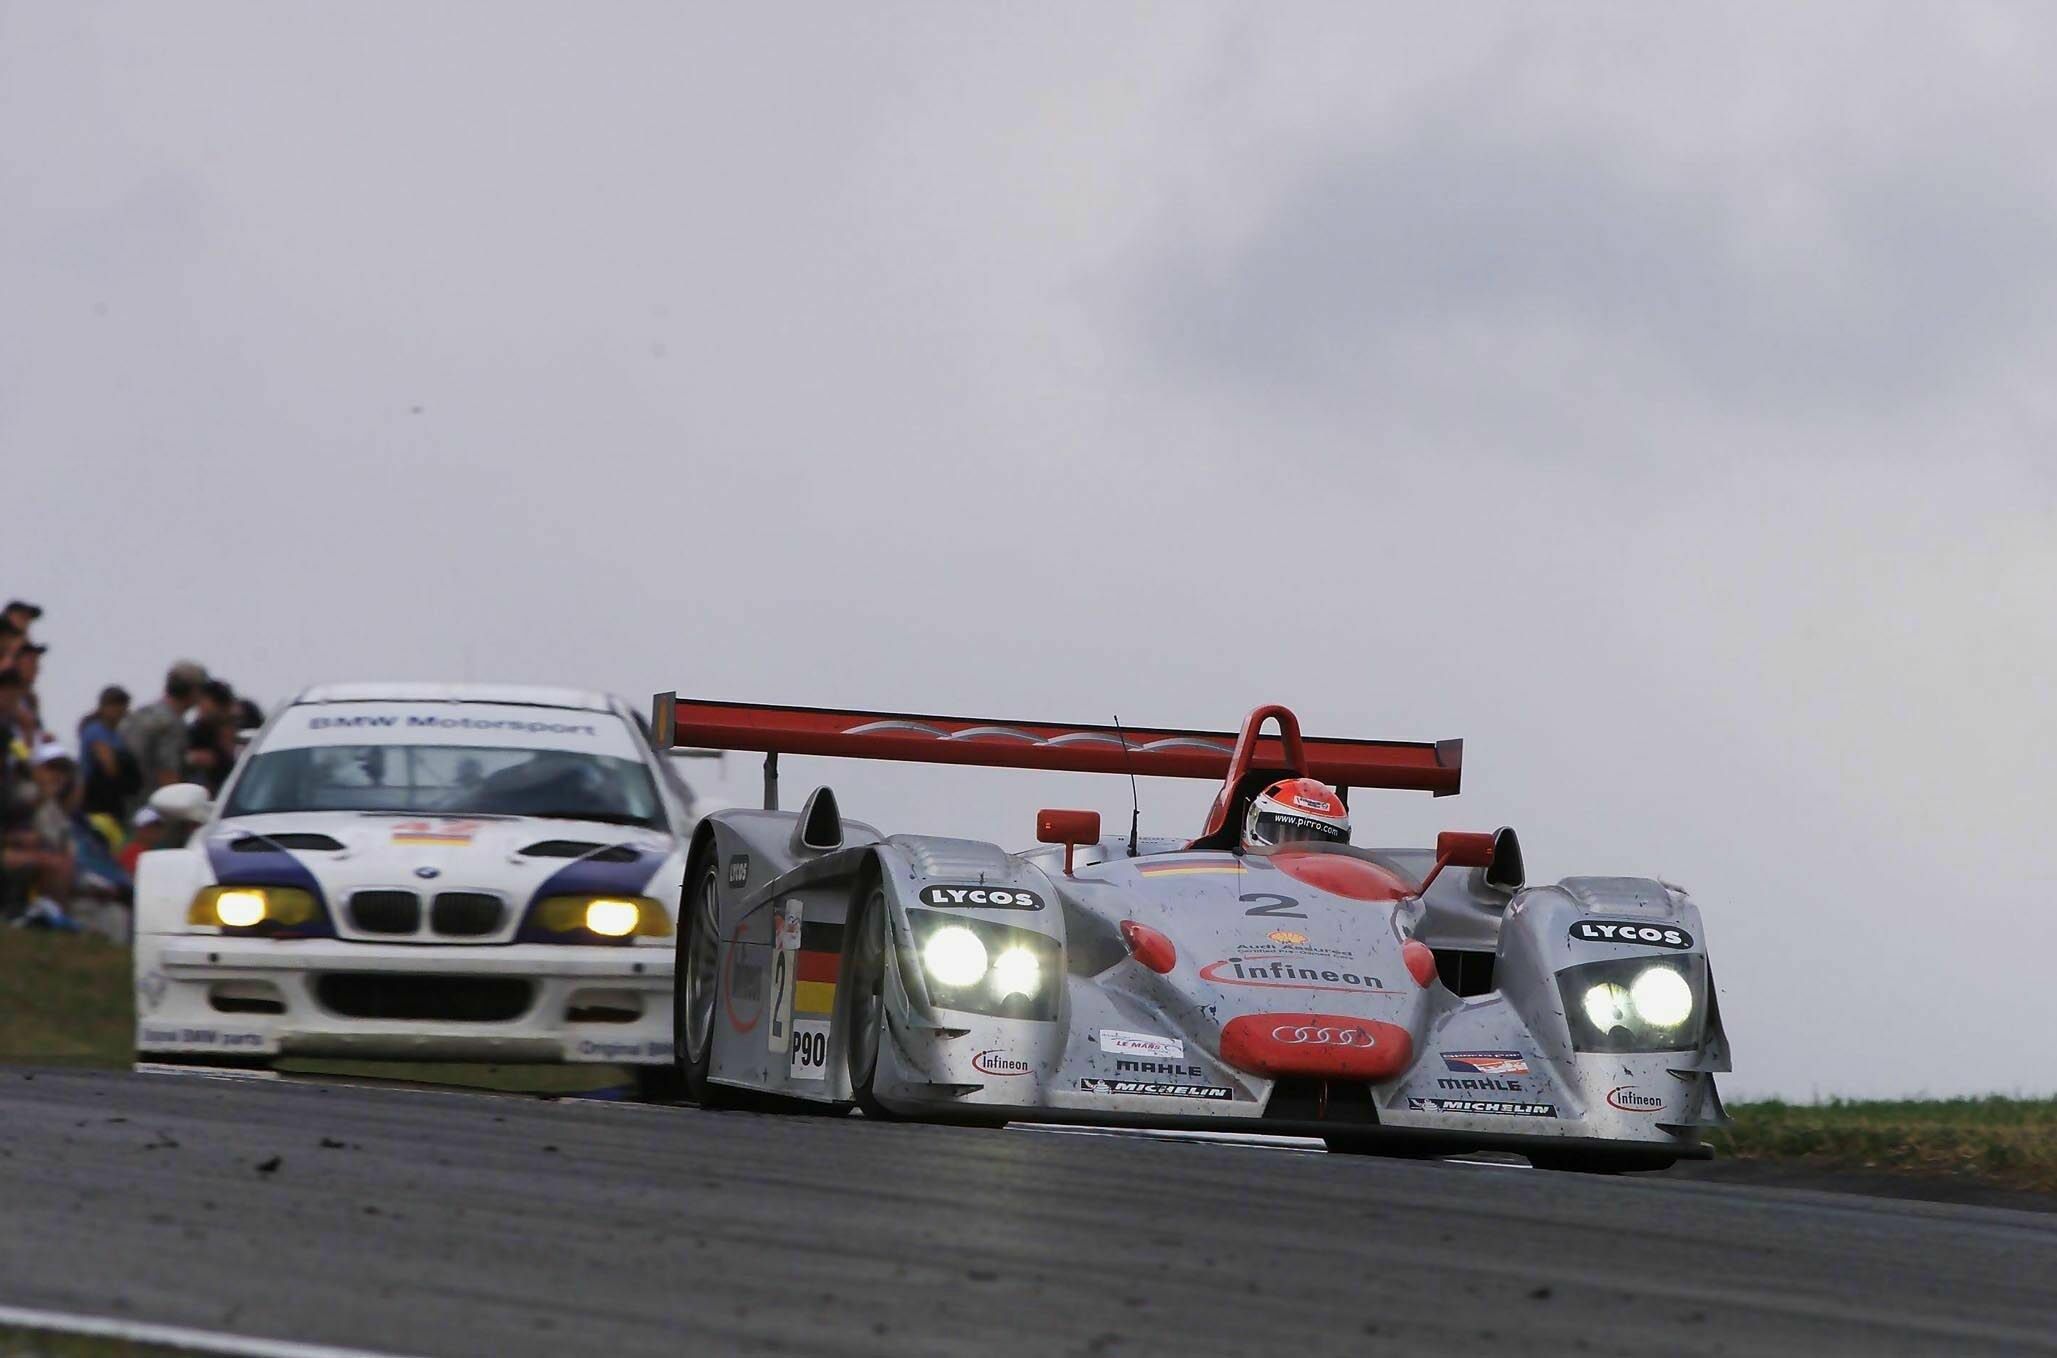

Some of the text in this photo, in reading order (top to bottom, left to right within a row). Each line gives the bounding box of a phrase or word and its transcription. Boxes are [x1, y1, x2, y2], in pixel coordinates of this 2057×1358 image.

[309, 716, 596, 735] BMW Motorsport
[1274, 815, 1339, 836] www.pirro.com
[931, 889, 1033, 906] LYCOS
[1239, 893, 1308, 919] 2
[1581, 924, 1682, 944] LYCOS
[772, 951, 786, 1038] 2
[791, 1031, 830, 1067] P90
[1116, 1060, 1201, 1077] MAHLE
[1115, 1082, 1227, 1097] MICHELIN
[1437, 1078, 1522, 1091] MAHLE
[1442, 1101, 1549, 1114] MICHELIN
